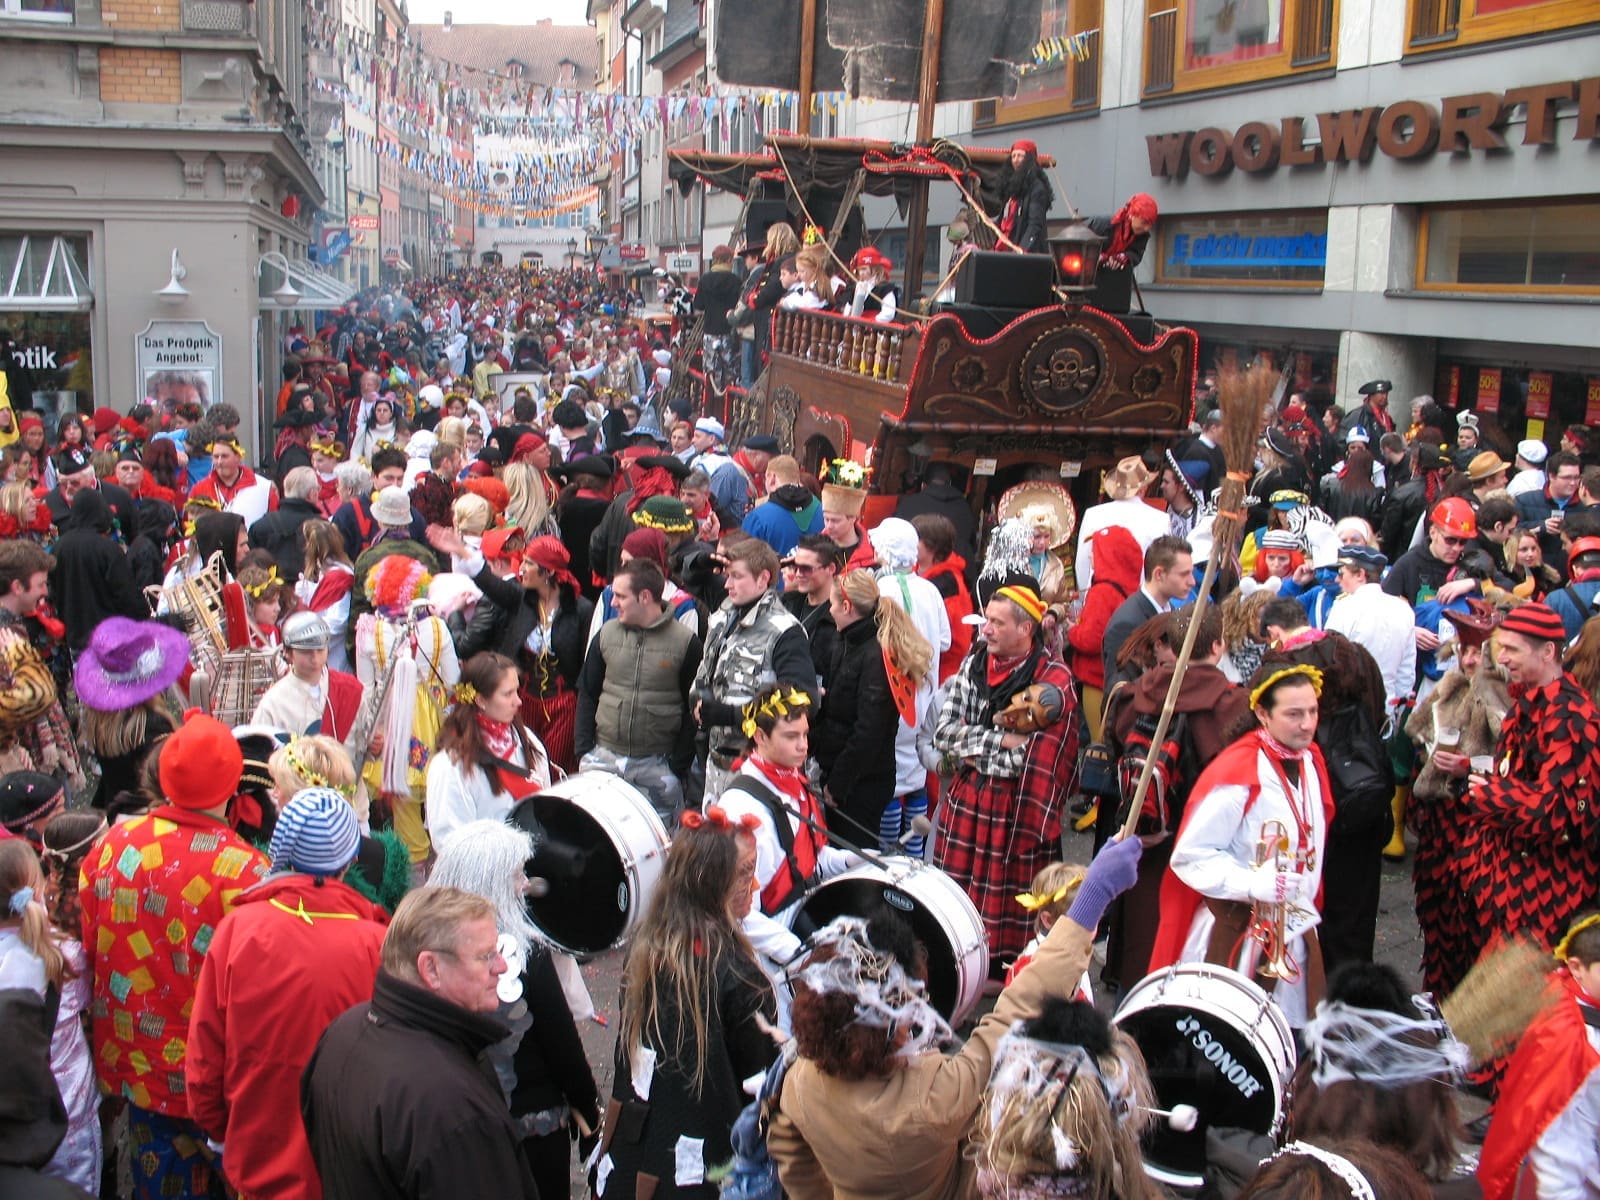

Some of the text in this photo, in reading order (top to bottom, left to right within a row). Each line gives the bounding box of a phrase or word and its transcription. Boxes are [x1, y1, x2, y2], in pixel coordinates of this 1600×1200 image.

[1192, 232, 1251, 258] aktiv
[1252, 231, 1327, 258] markt
[144, 337, 164, 348] Das
[156, 352, 204, 365] Angebot:
[1479, 375, 1500, 390] 50%
[1192, 1029, 1262, 1099] SONOR
